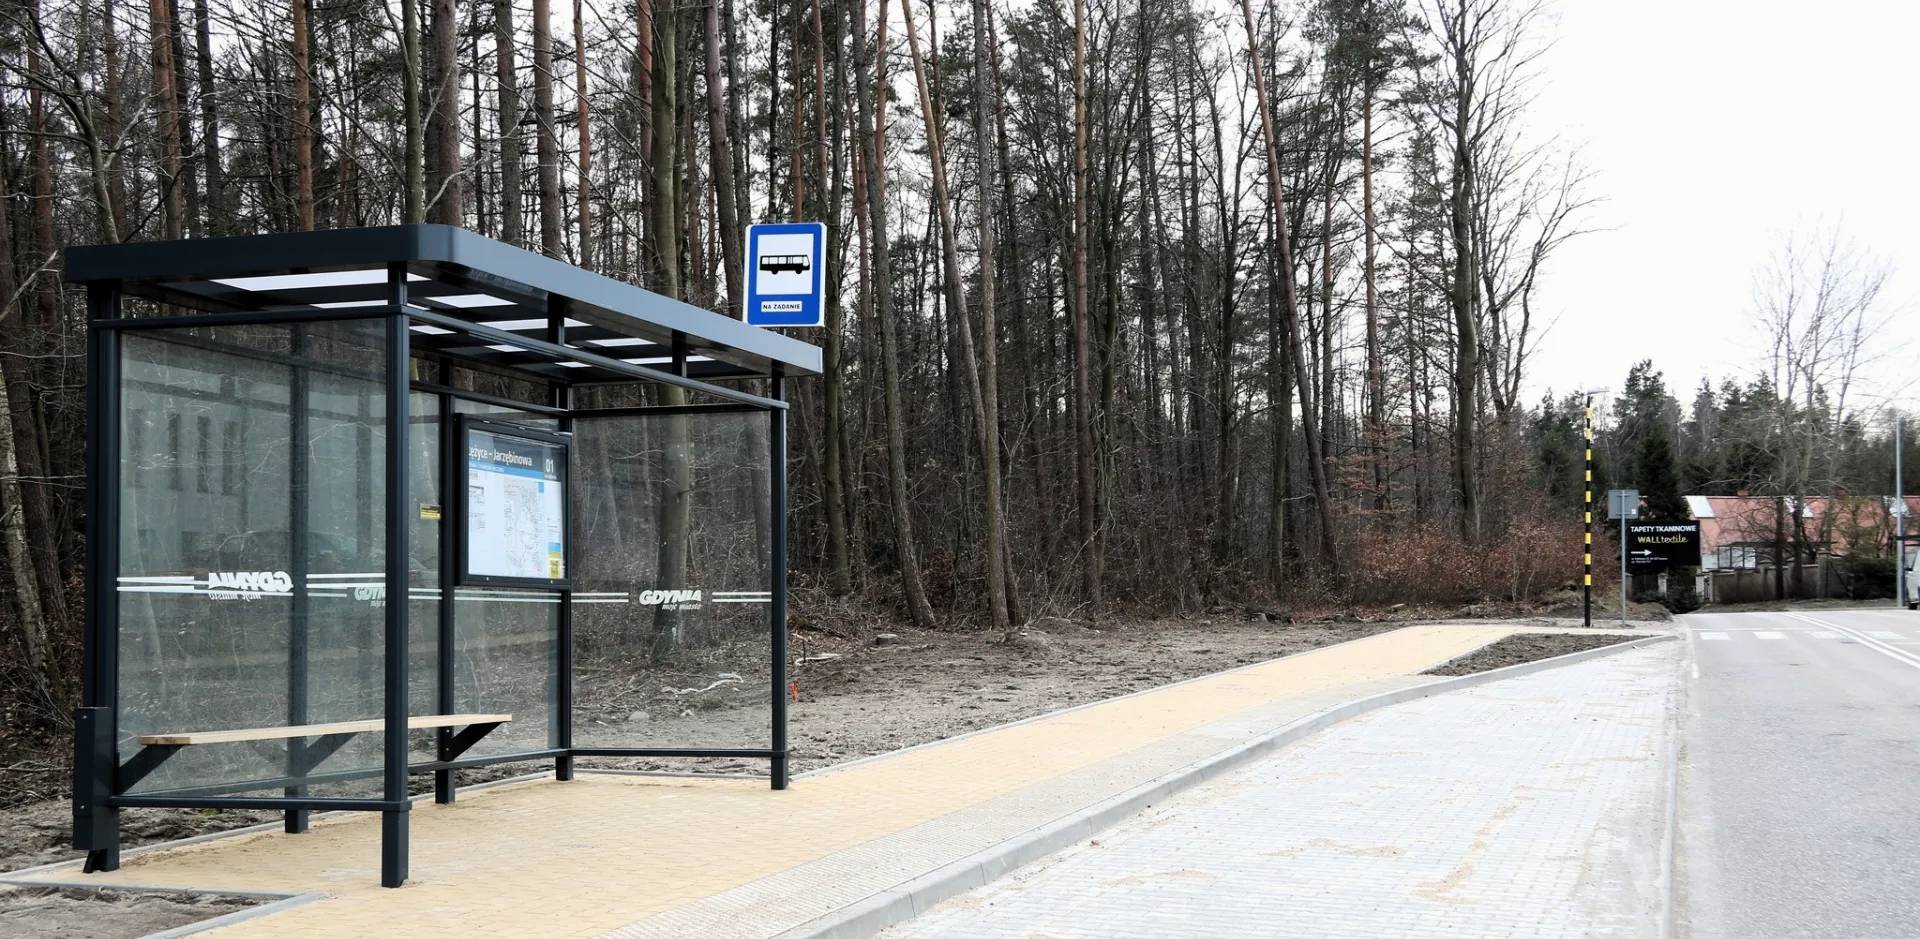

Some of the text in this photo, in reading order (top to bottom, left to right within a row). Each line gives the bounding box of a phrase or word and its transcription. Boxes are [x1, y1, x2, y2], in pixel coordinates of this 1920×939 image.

[493, 448, 533, 467] Jarzębinowa
[545, 459, 554, 473] 01
[639, 590, 702, 605] GDYNIA
